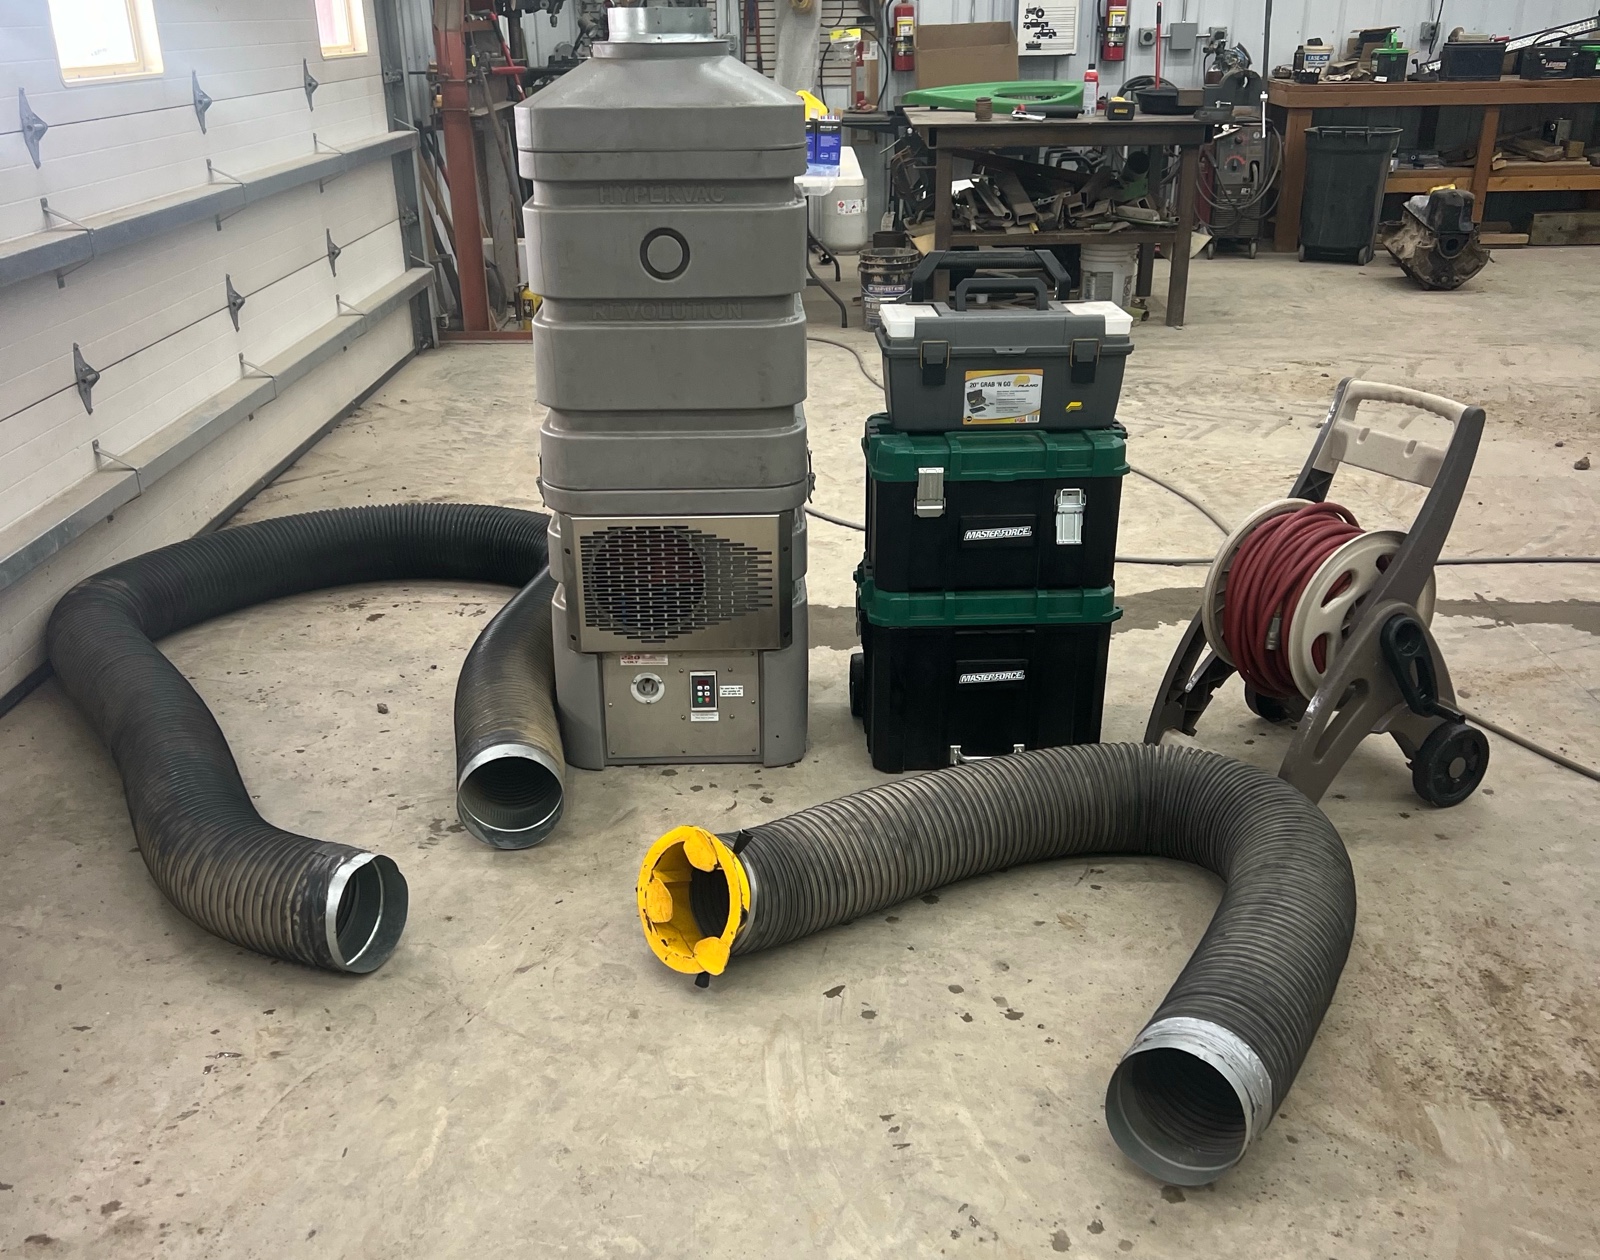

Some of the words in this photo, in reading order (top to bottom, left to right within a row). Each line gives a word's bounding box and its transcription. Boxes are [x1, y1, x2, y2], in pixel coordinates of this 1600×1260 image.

[599, 184, 725, 204] HYPERVAC
[592, 301, 743, 320] REVOLUTION
[964, 526, 1032, 540] MASTERFORCE
[959, 670, 1025, 684] MASTERFORCE
